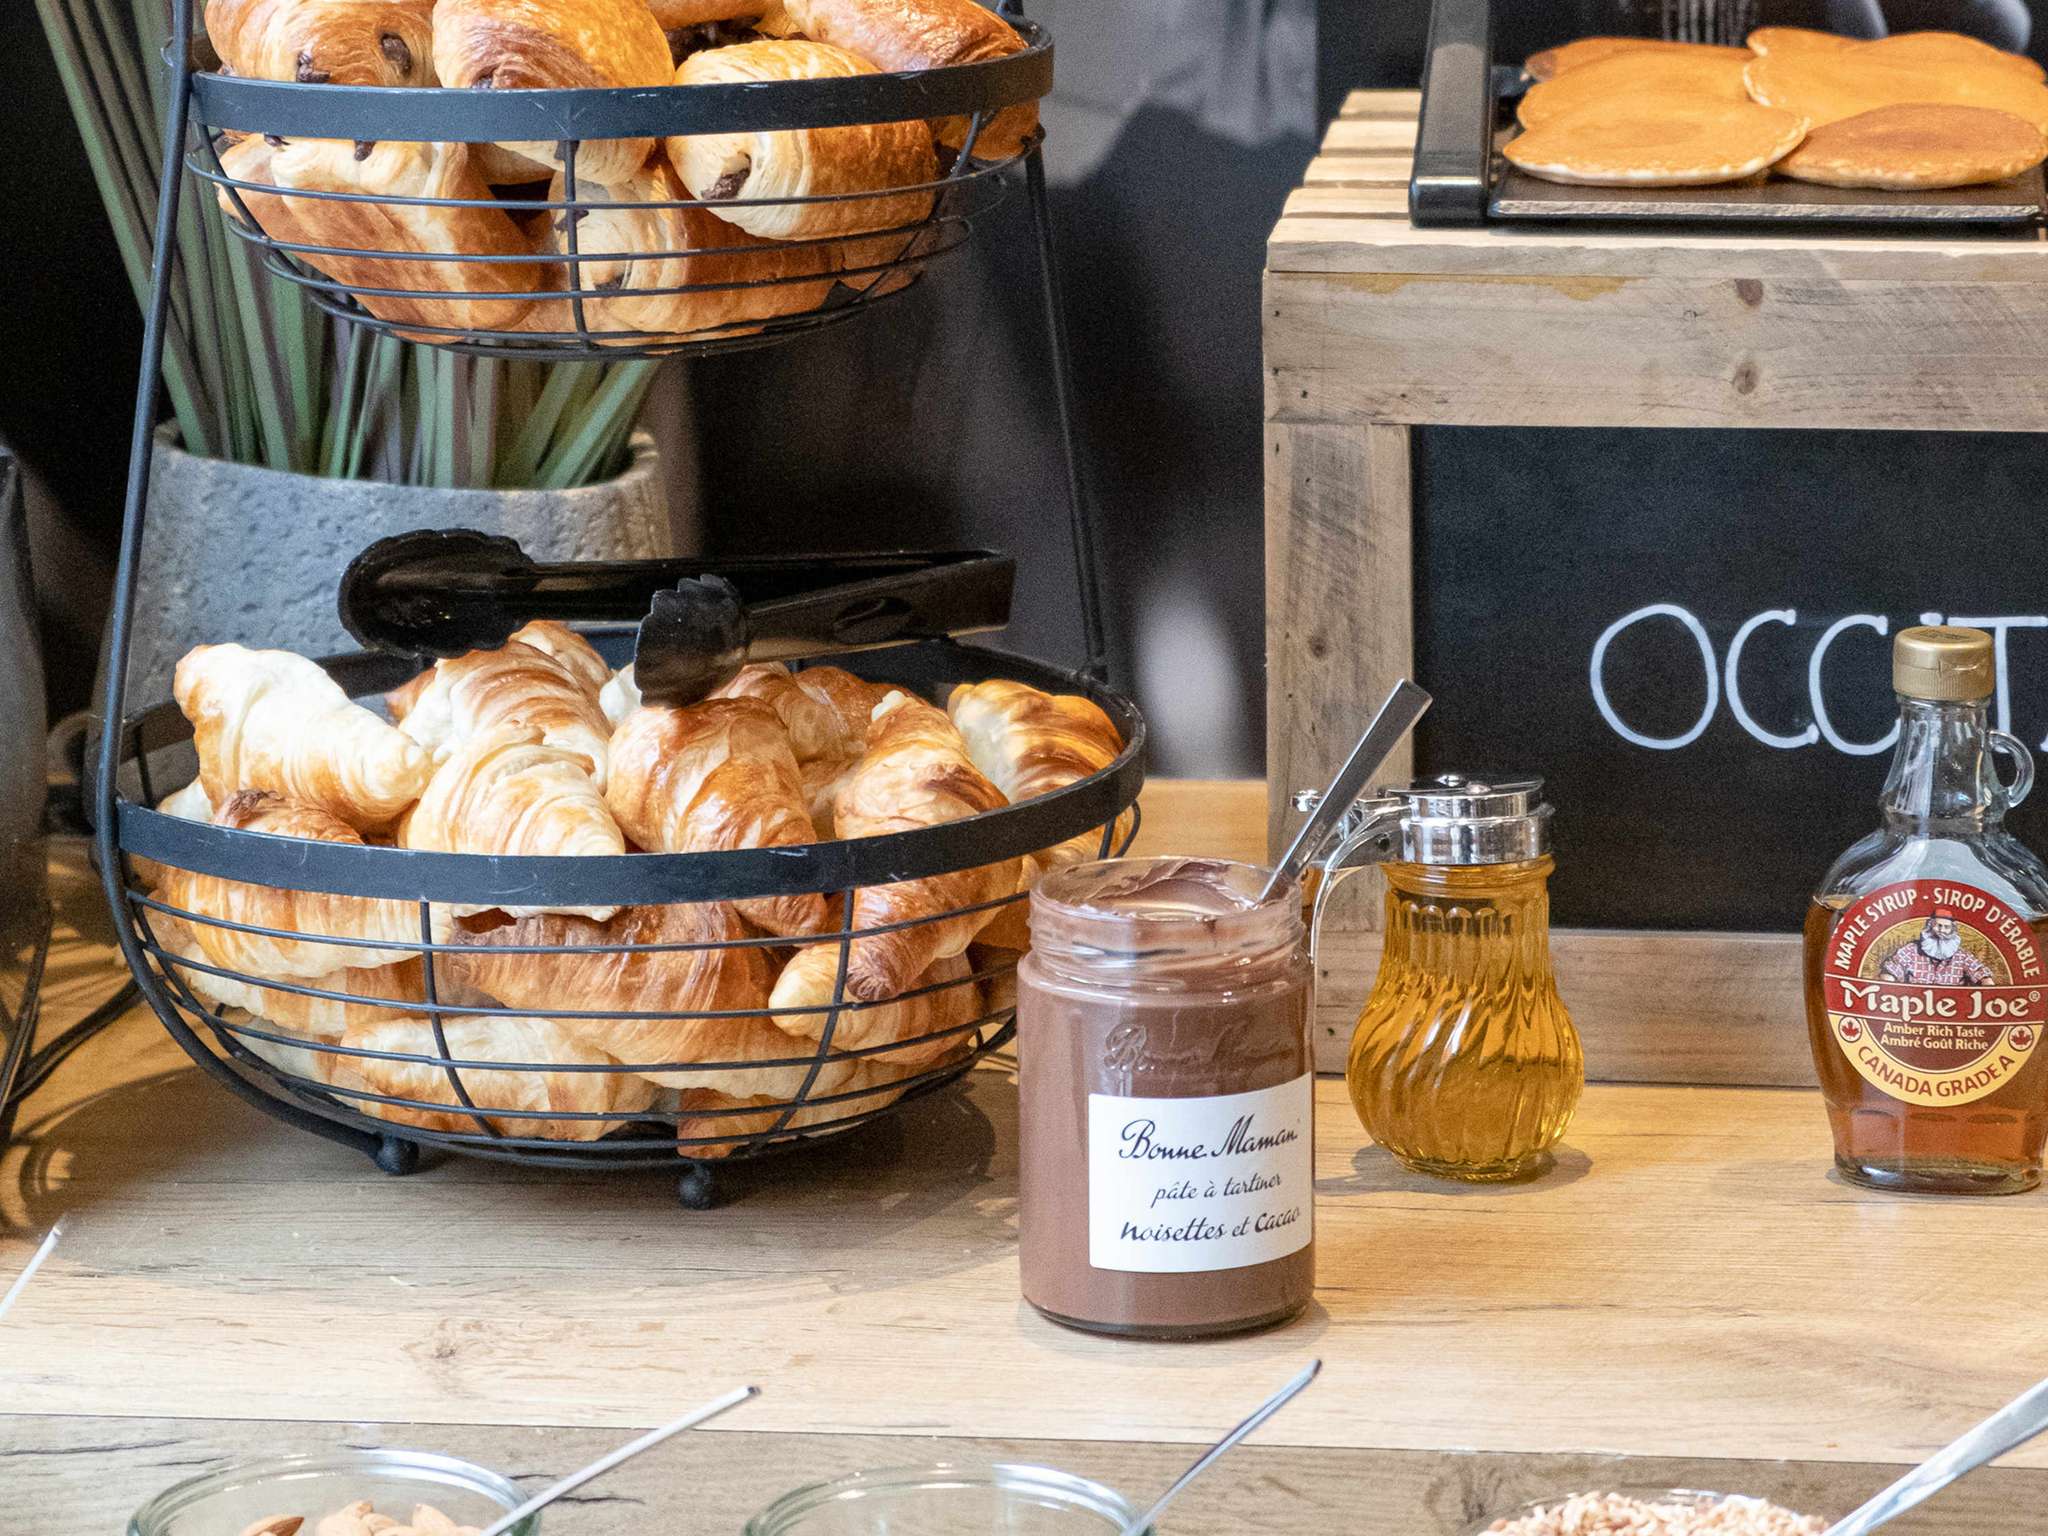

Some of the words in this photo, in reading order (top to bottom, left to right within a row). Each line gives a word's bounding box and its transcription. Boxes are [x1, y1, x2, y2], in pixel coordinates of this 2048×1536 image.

[1590, 603, 2048, 755] OCCT
[1834, 914, 1870, 970] MAPLE
[1865, 888, 1918, 922] SYRUP
[1933, 887, 1986, 912] SIROP
[1985, 906, 2041, 978] D'ÉRABLE
[1840, 980, 1957, 1021] Maple
[1881, 1034, 1920, 1047] Ambré
[1923, 1036, 1953, 1049] Goût
[1955, 1038, 1989, 1050] Riche
[1883, 1021, 1924, 1035] Amber
[1928, 1025, 1954, 1037] Rich
[1957, 1026, 1985, 1037] Taste
[1858, 1046, 1932, 1096] CANADA
[1936, 1065, 2002, 1097] GRADE
[1998, 1054, 2016, 1071] A
[1119, 1118, 1207, 1161] Bonne
[1211, 1113, 1298, 1157] Maman
[1151, 1180, 1199, 1208] pâte
[1203, 1180, 1217, 1198] à
[1223, 1172, 1282, 1197] tartiner
[1231, 1219, 1250, 1236] et
